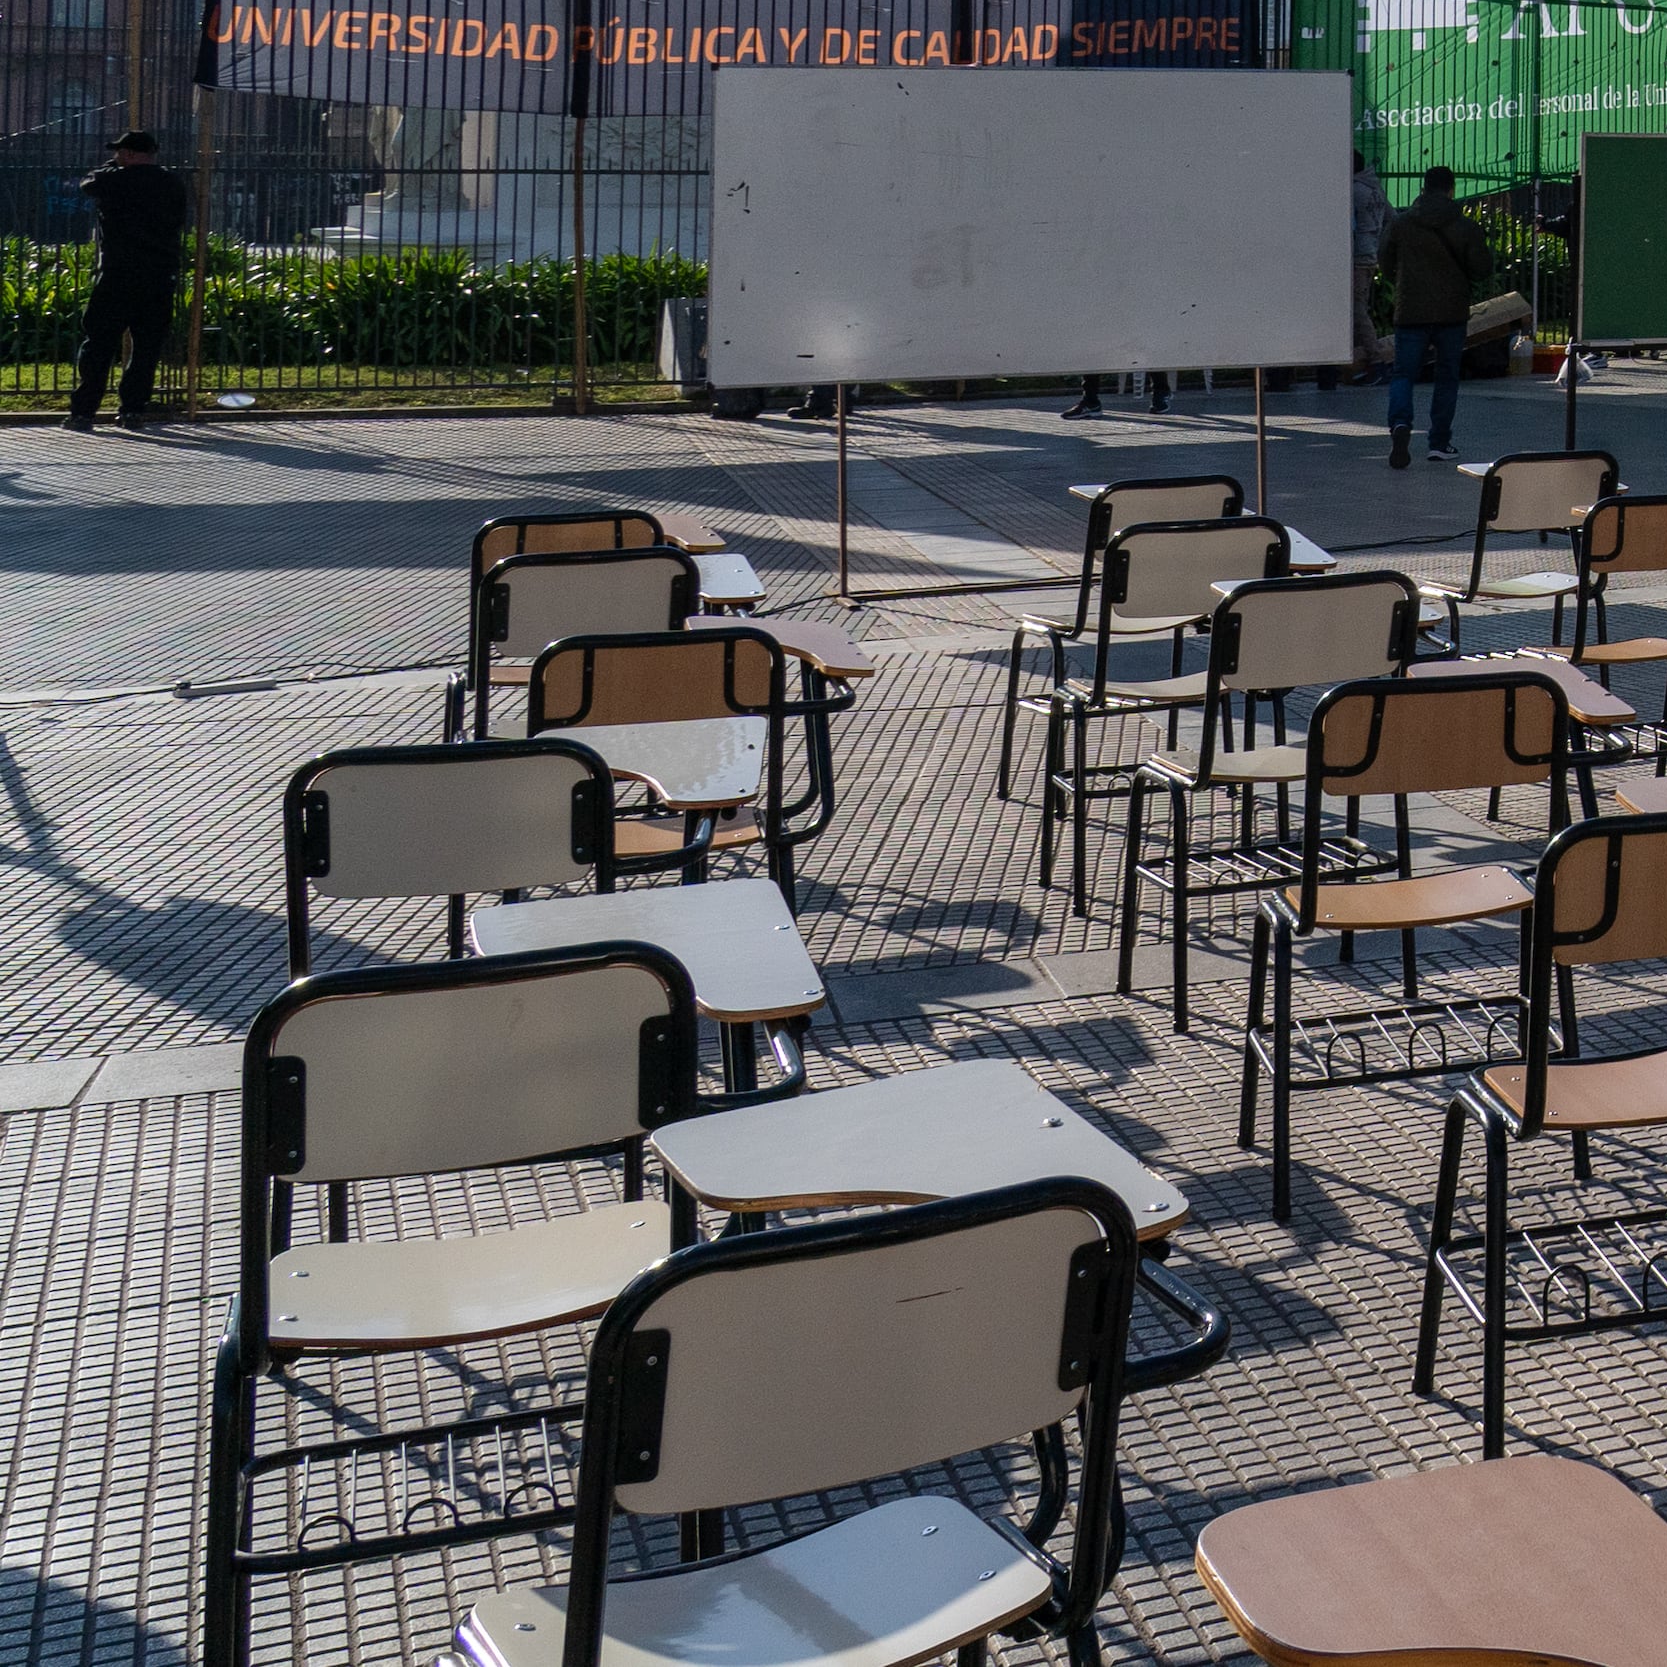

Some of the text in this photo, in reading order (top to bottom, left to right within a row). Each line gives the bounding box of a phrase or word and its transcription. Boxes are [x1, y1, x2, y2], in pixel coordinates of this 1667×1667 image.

[207, 5, 1241, 67] UNIVERSIDAD PÚBLICA Y DE CALIDAD SIEMPRE
[1355, 96, 1482, 131] Asociación
[1489, 92, 1526, 120] del
[1603, 85, 1623, 110] de
[1626, 84, 1640, 108] la
